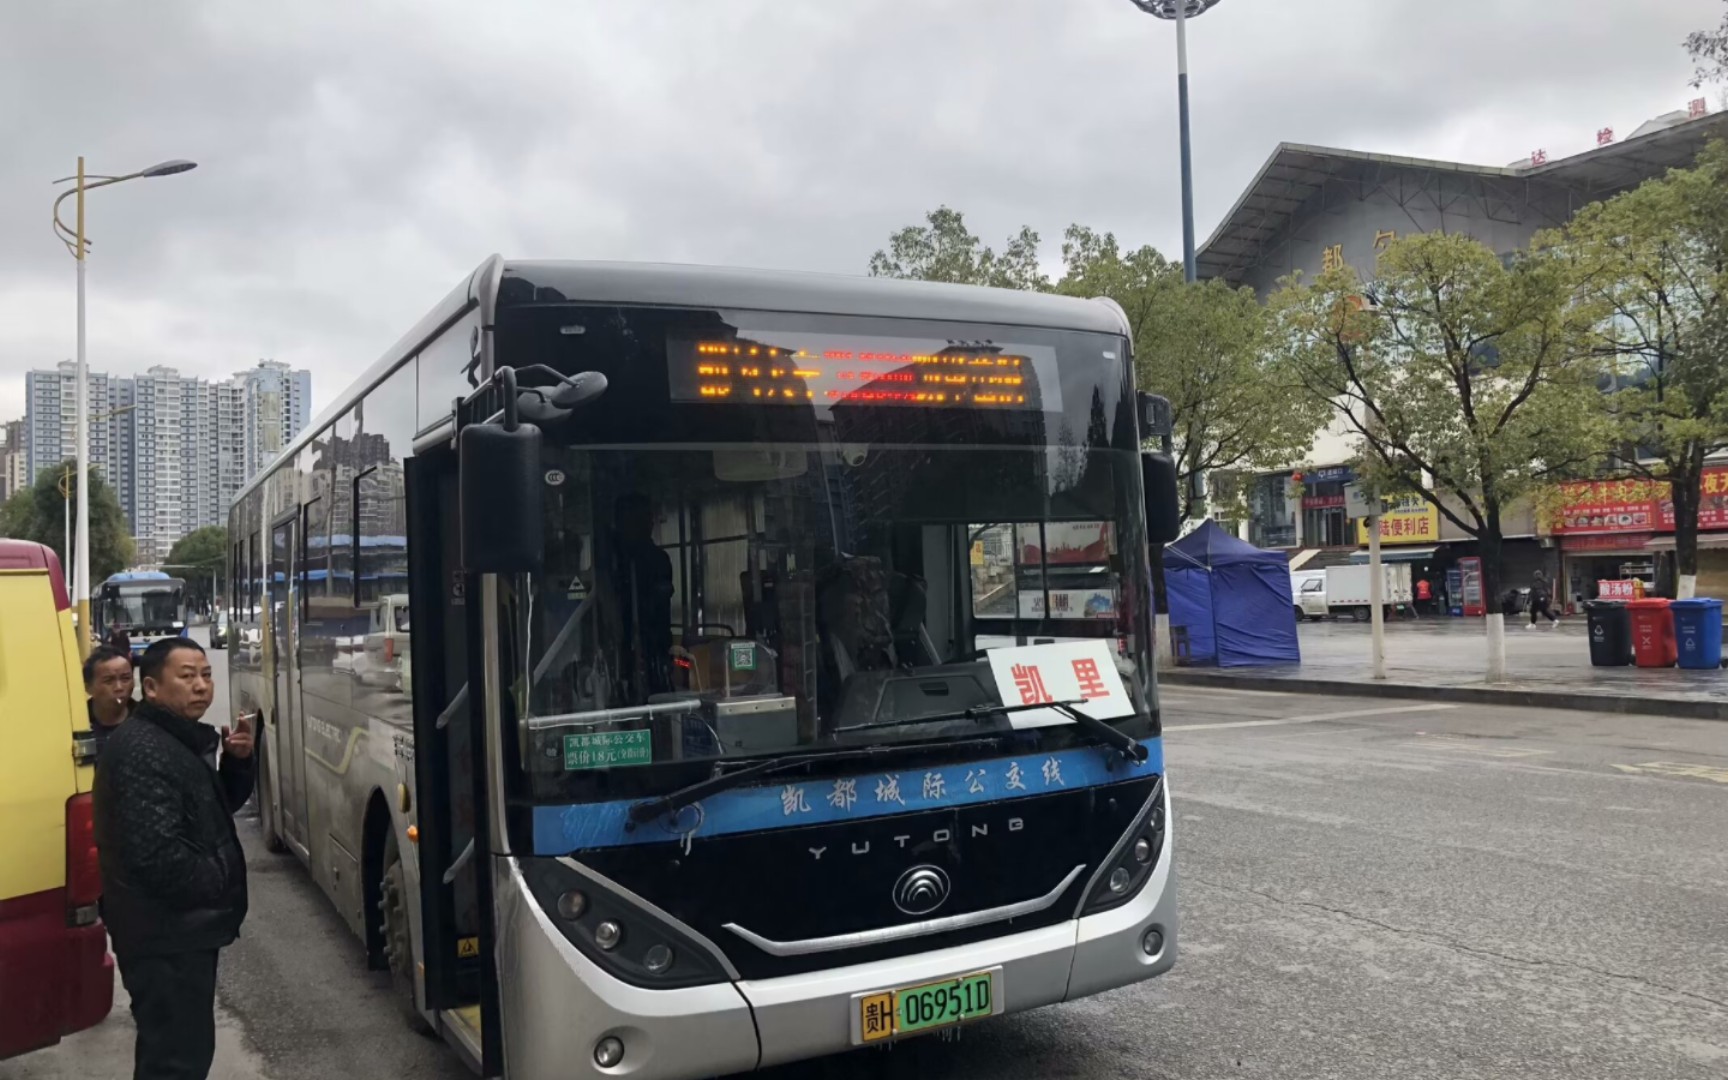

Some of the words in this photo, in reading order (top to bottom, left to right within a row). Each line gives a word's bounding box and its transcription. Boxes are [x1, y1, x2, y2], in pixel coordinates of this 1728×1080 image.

[1599, 582, 1633, 596] 酸汤粉
[1010, 658, 1110, 706] 凯里
[780, 756, 1065, 816] 凯都城际公交线
[809, 817, 1024, 860] YUTONG
